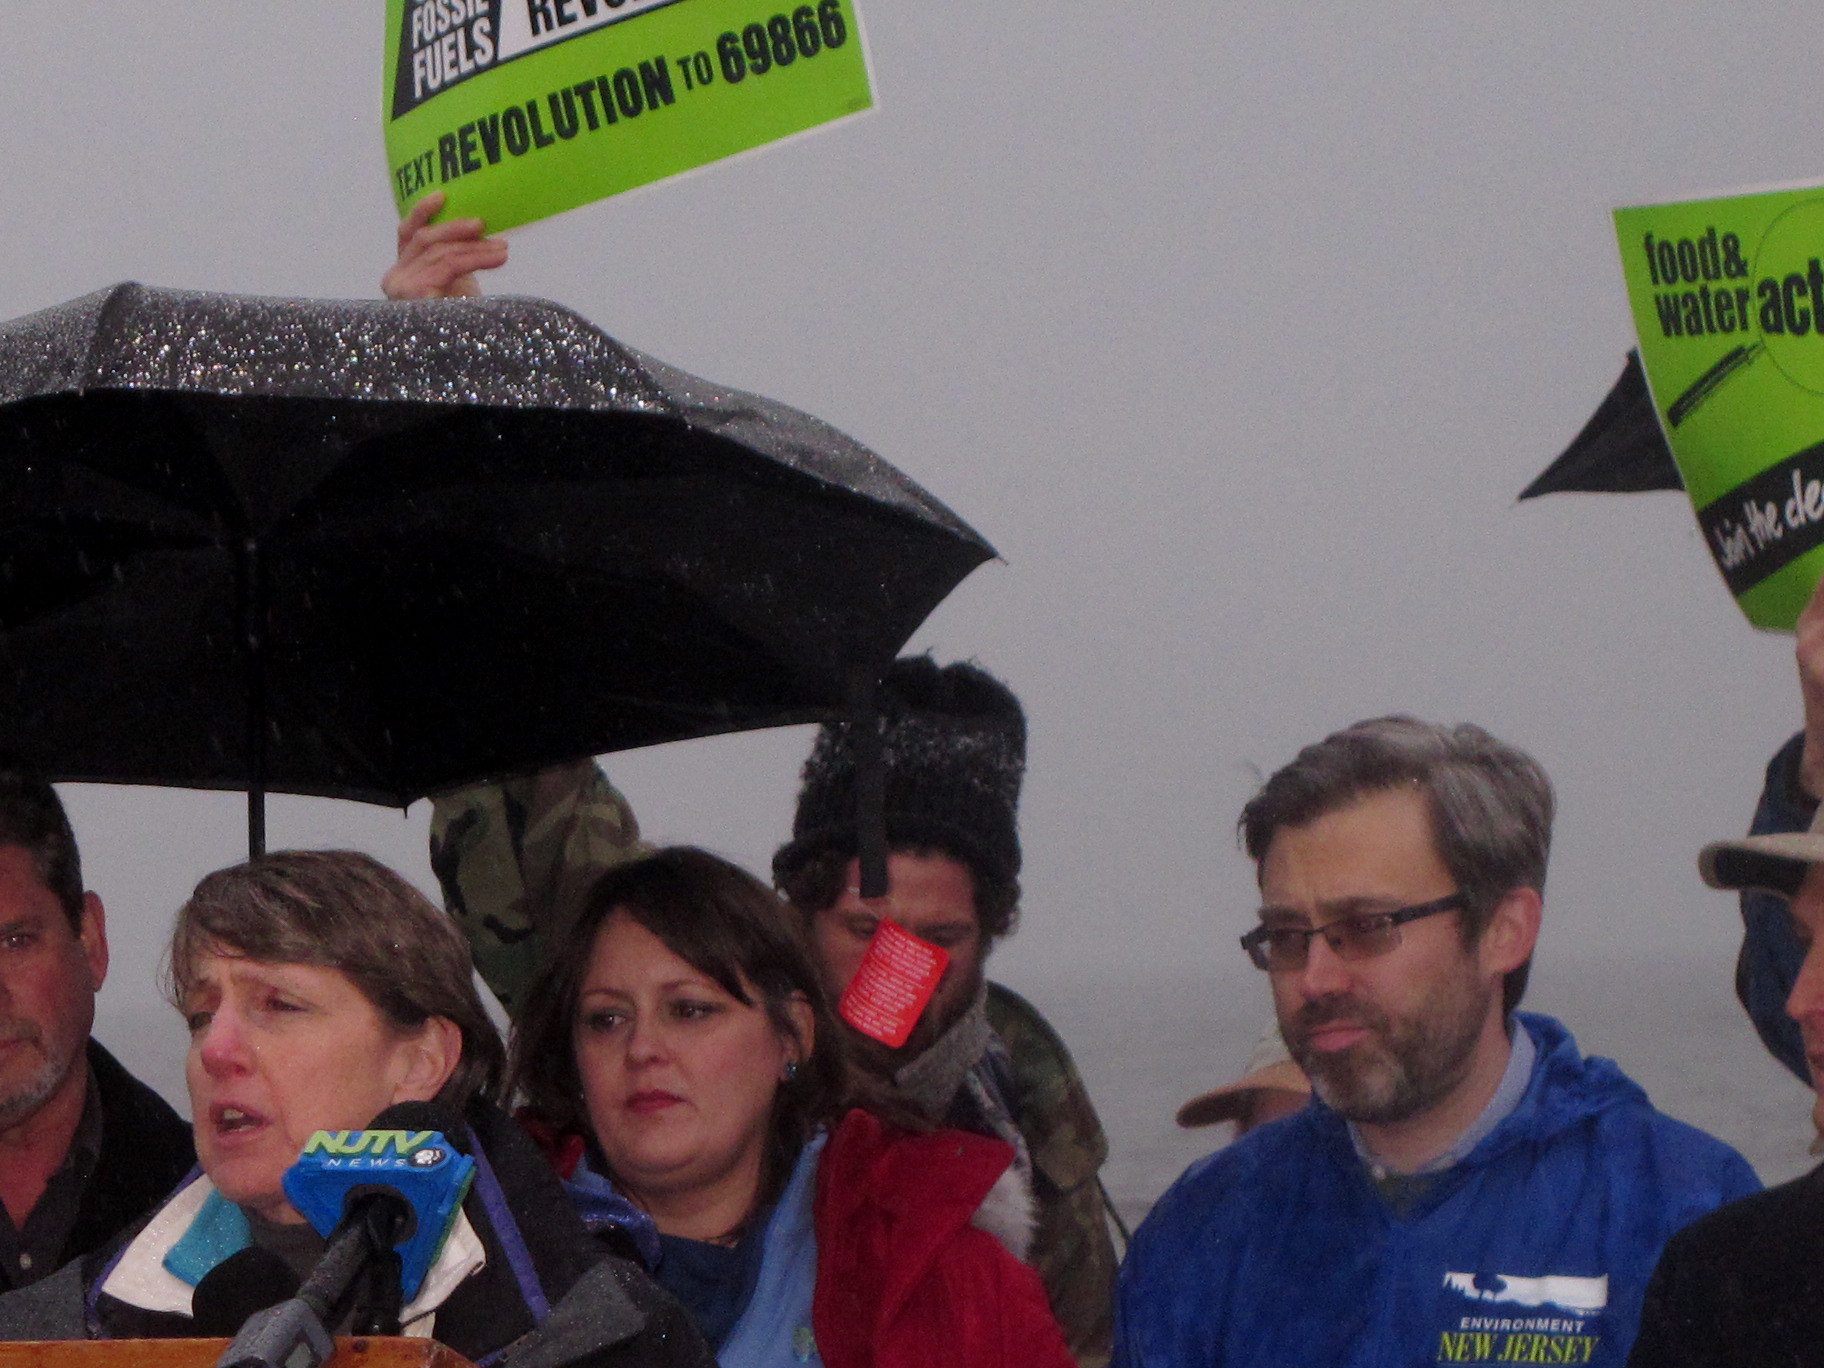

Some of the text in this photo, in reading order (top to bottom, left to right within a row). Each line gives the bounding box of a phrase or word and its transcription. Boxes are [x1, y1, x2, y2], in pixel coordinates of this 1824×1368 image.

[412, 17, 495, 98] FUELS
[396, 0, 847, 202] TEXT REVOLUTION TO 69866
[1655, 286, 1750, 338] water
[1784, 468, 1824, 531] de
[303, 1130, 434, 1156] NJTV
[327, 1158, 407, 1168] NEWS
[1460, 1316, 1585, 1333] ENVIRONMENT
[1437, 1331, 1601, 1364] NEW JERSEY
